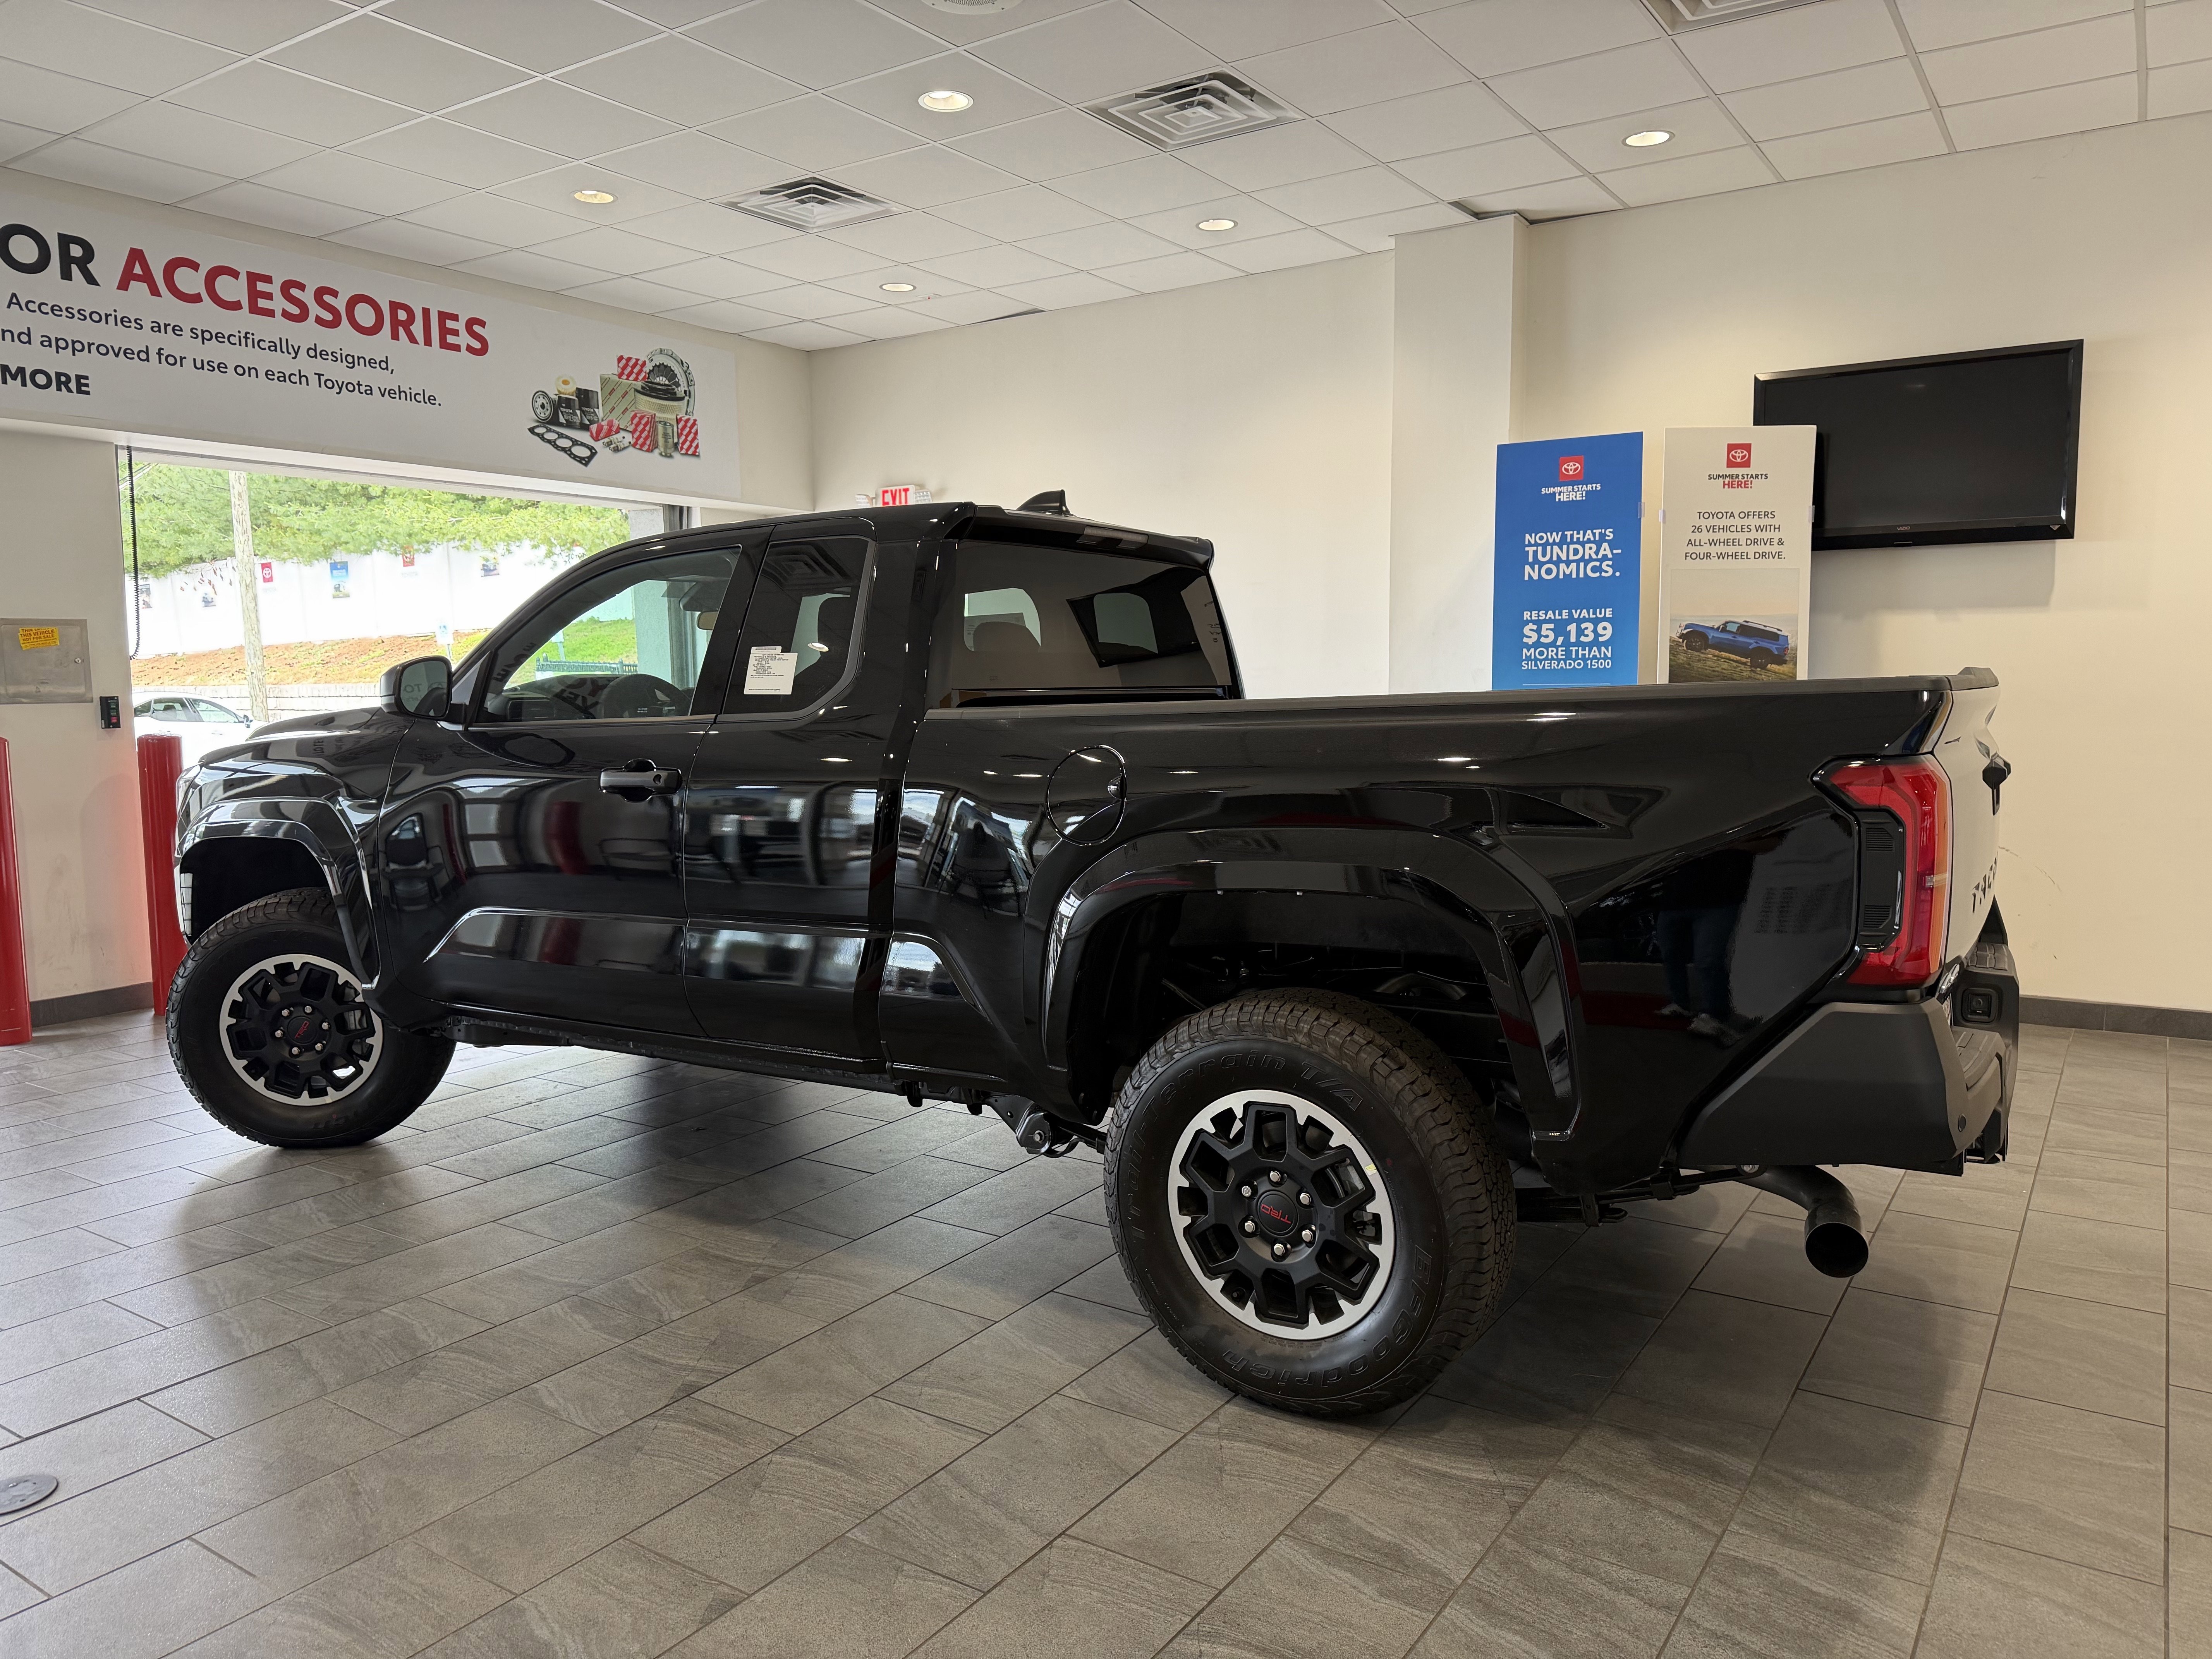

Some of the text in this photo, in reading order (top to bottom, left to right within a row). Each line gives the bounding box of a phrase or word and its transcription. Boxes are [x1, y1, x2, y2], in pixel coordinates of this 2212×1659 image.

[0, 223, 489, 357] OR ACCESSORIES
[6, 292, 394, 374] Accessories are specifically designed,
[1, 326, 441, 407] nd approved for use on each Toyota vehicle.
[0, 364, 91, 396] MORE
[1541, 484, 1601, 494] SUMMER STARTS
[1723, 480, 1753, 489] HERE!
[882, 488, 910, 506] EXIT
[1556, 491, 1586, 501] HERE!
[1697, 511, 1776, 520] TOYOTA OFFERS
[1525, 529, 1614, 544] NOW THAT'S
[1691, 524, 1780, 533] 26 VEHICLES WITH
[1686, 538, 1784, 547] ALL-WHEEL DRIVE &
[1525, 542, 1622, 562] TUNDRA-
[1685, 551, 1786, 560] FOUR-WHEEL DRIVE.
[1524, 560, 1620, 580] NOMICS.
[1523, 608, 1613, 620] RESALE VALUE
[1523, 622, 1613, 646] $5,139
[1522, 646, 1611, 659] MORE THAN
[1522, 659, 1611, 670] SILVERADO 1500
[295, 1020, 309, 1039] TRD
[1301, 1061, 1363, 1111] T/A
[1261, 1204, 1291, 1224] TRD
[1222, 1245, 1432, 1387] BFGoodrich
